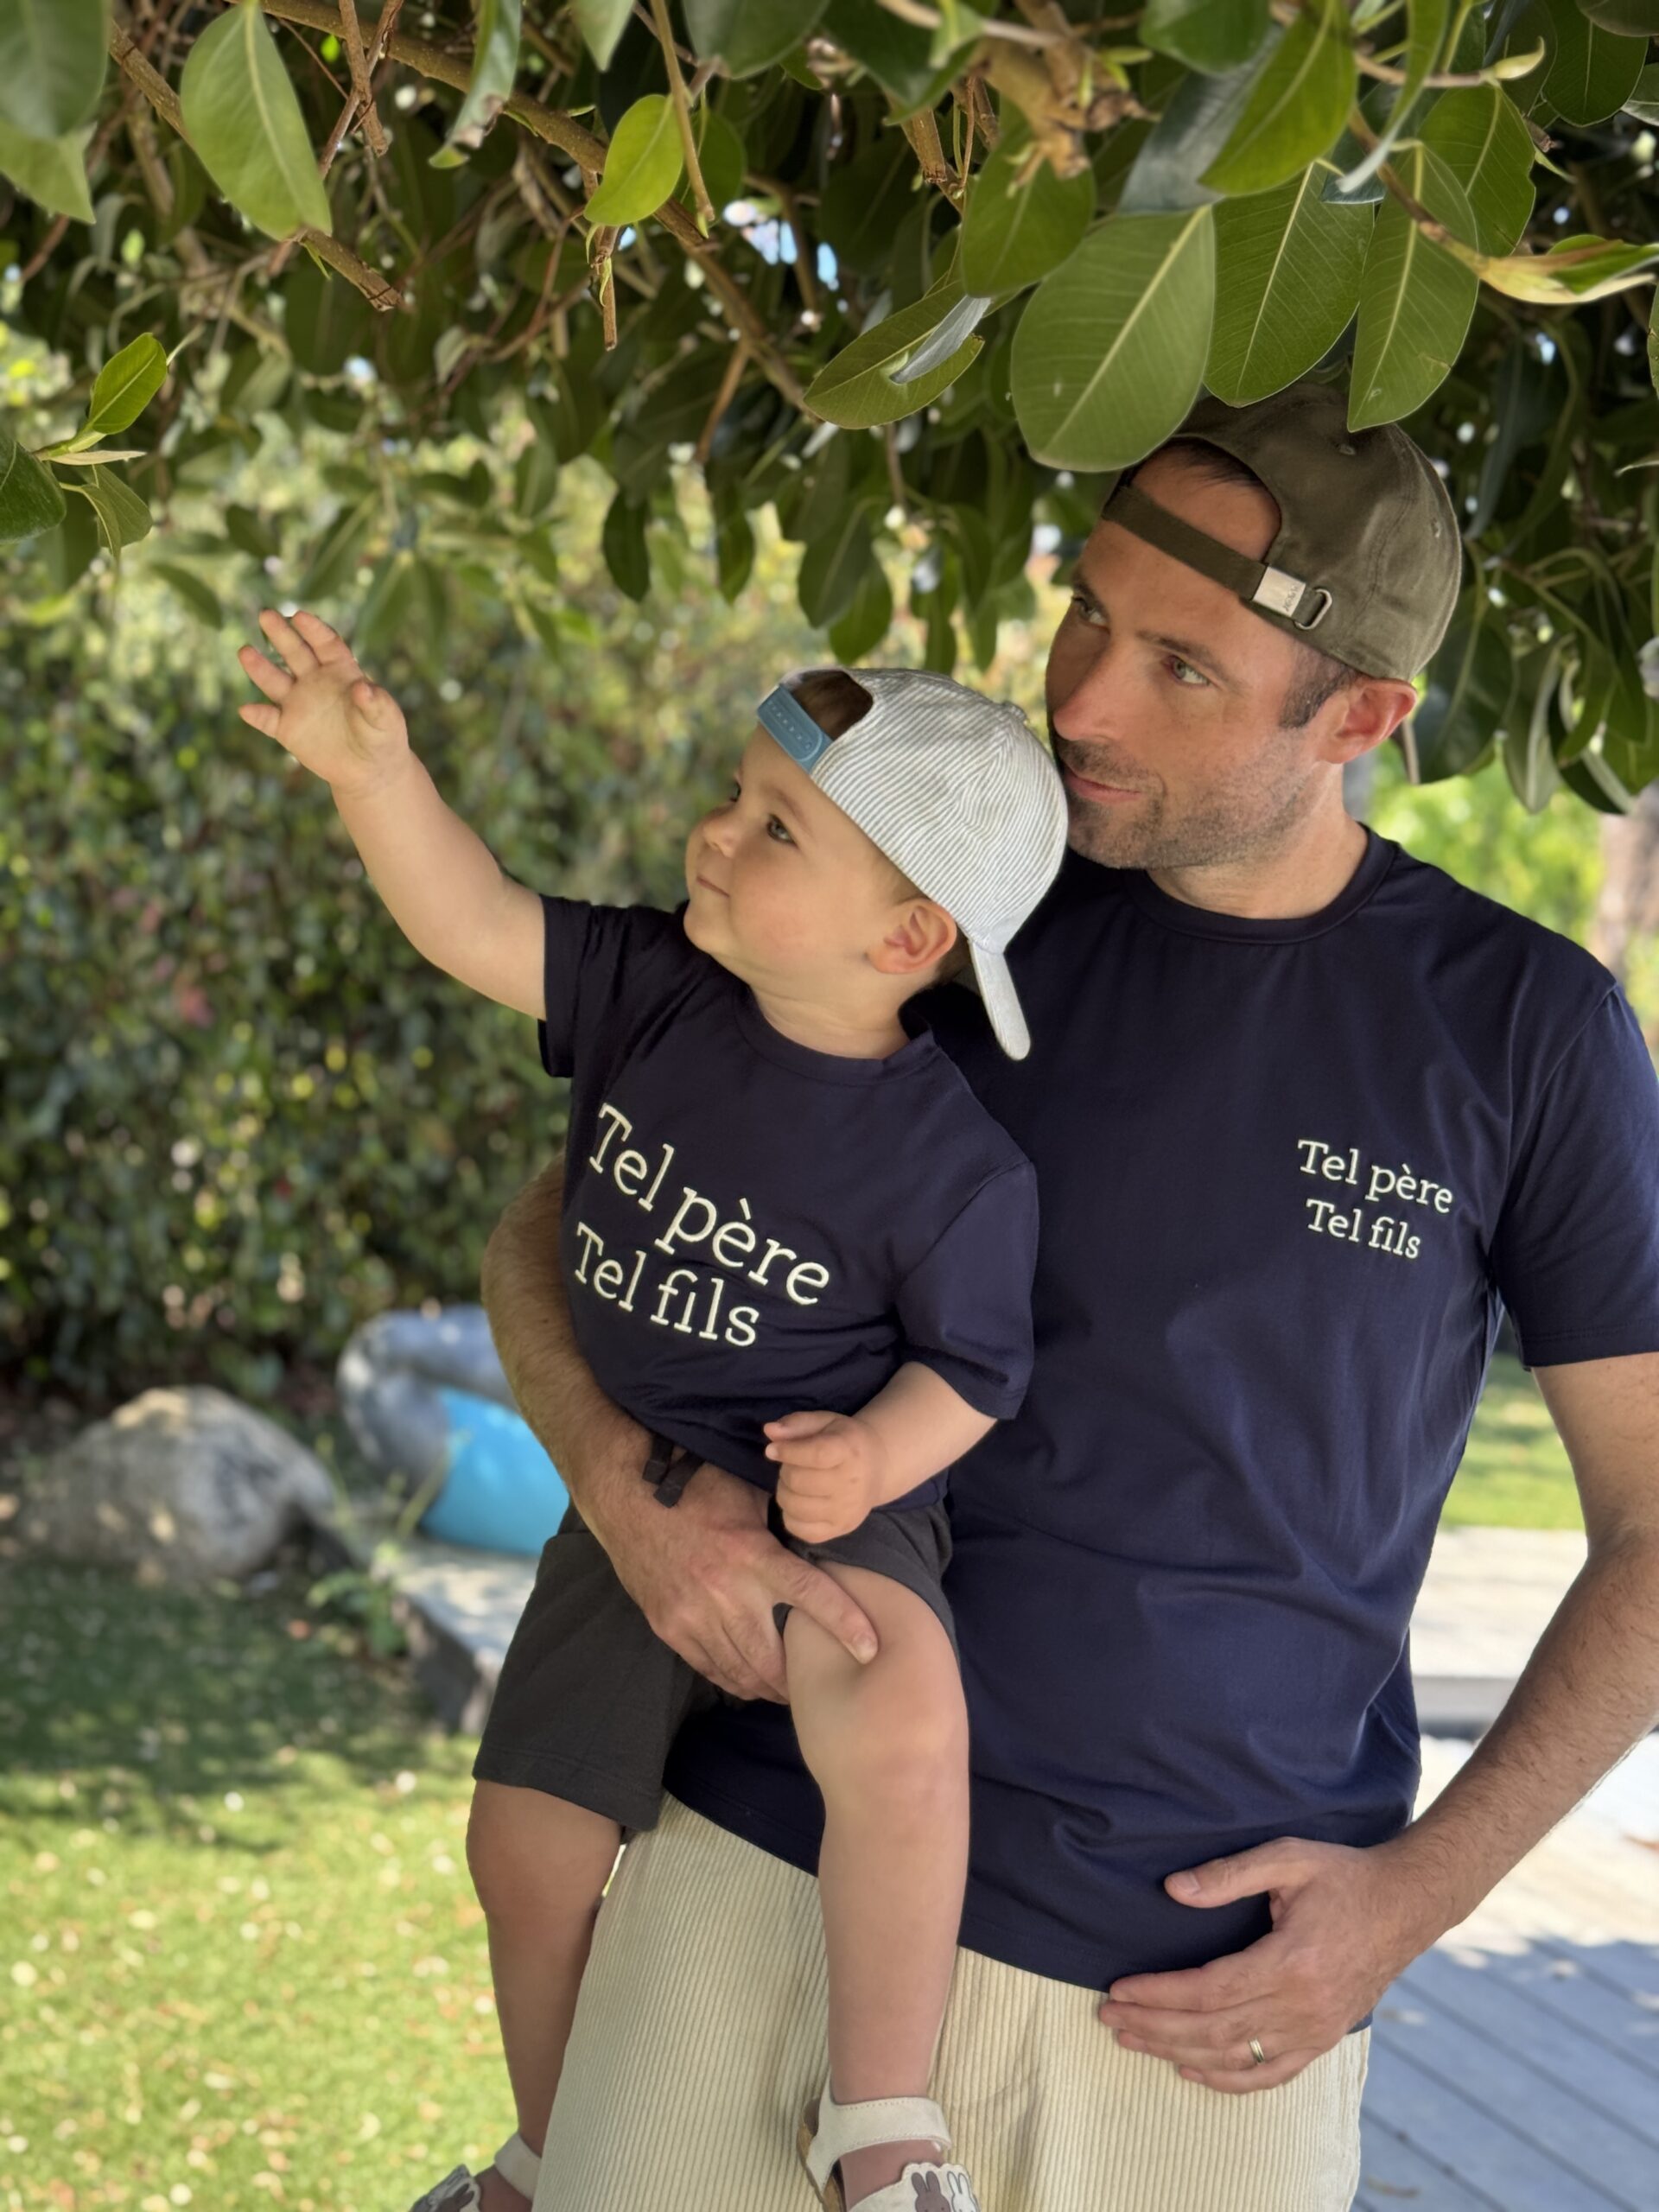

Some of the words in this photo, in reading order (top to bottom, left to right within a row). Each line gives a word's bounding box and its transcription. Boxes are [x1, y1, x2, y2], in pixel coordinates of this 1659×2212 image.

[589, 1103, 675, 1211] Tel
[654, 1186, 830, 1306] père
[1297, 1139, 1359, 1185] Tel
[1364, 1162, 1453, 1214] père
[1306, 1198, 1363, 1243] Tel
[1368, 1215, 1421, 1260] fils
[575, 1221, 647, 1312] Tel
[650, 1268, 760, 1347] fils
